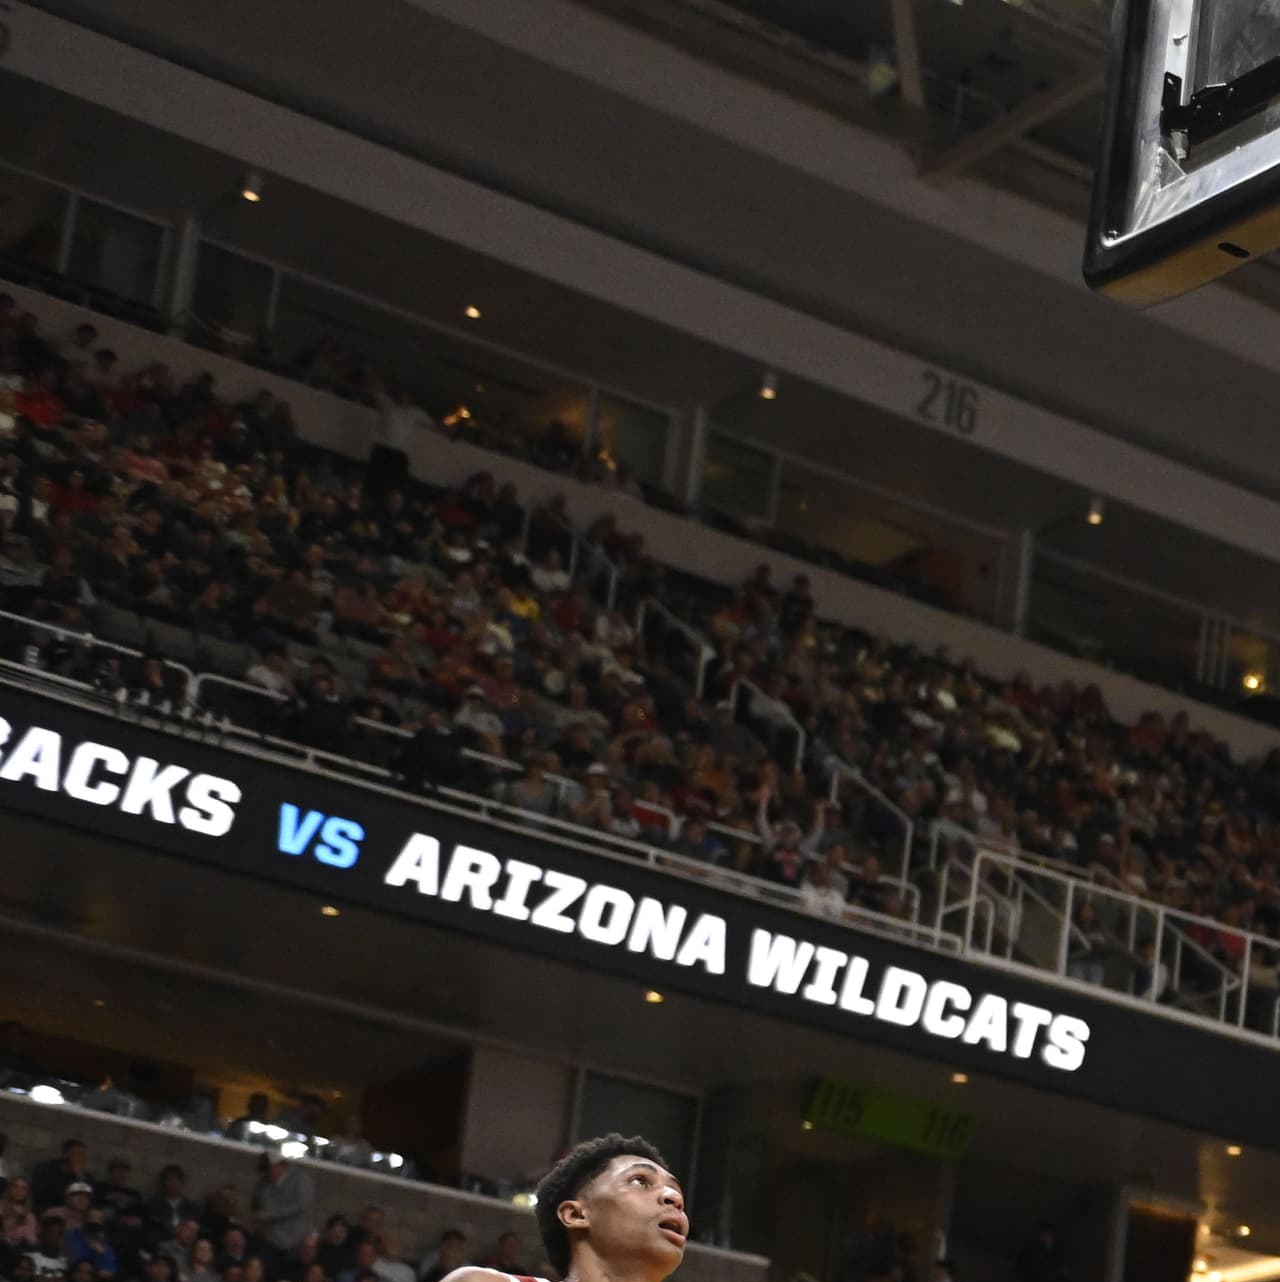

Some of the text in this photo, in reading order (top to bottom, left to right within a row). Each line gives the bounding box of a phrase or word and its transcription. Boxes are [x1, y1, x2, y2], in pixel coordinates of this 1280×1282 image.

[917, 369, 979, 434] 216
[0, 716, 1092, 1072] ACKS VS ARIZONA WILDCATS
